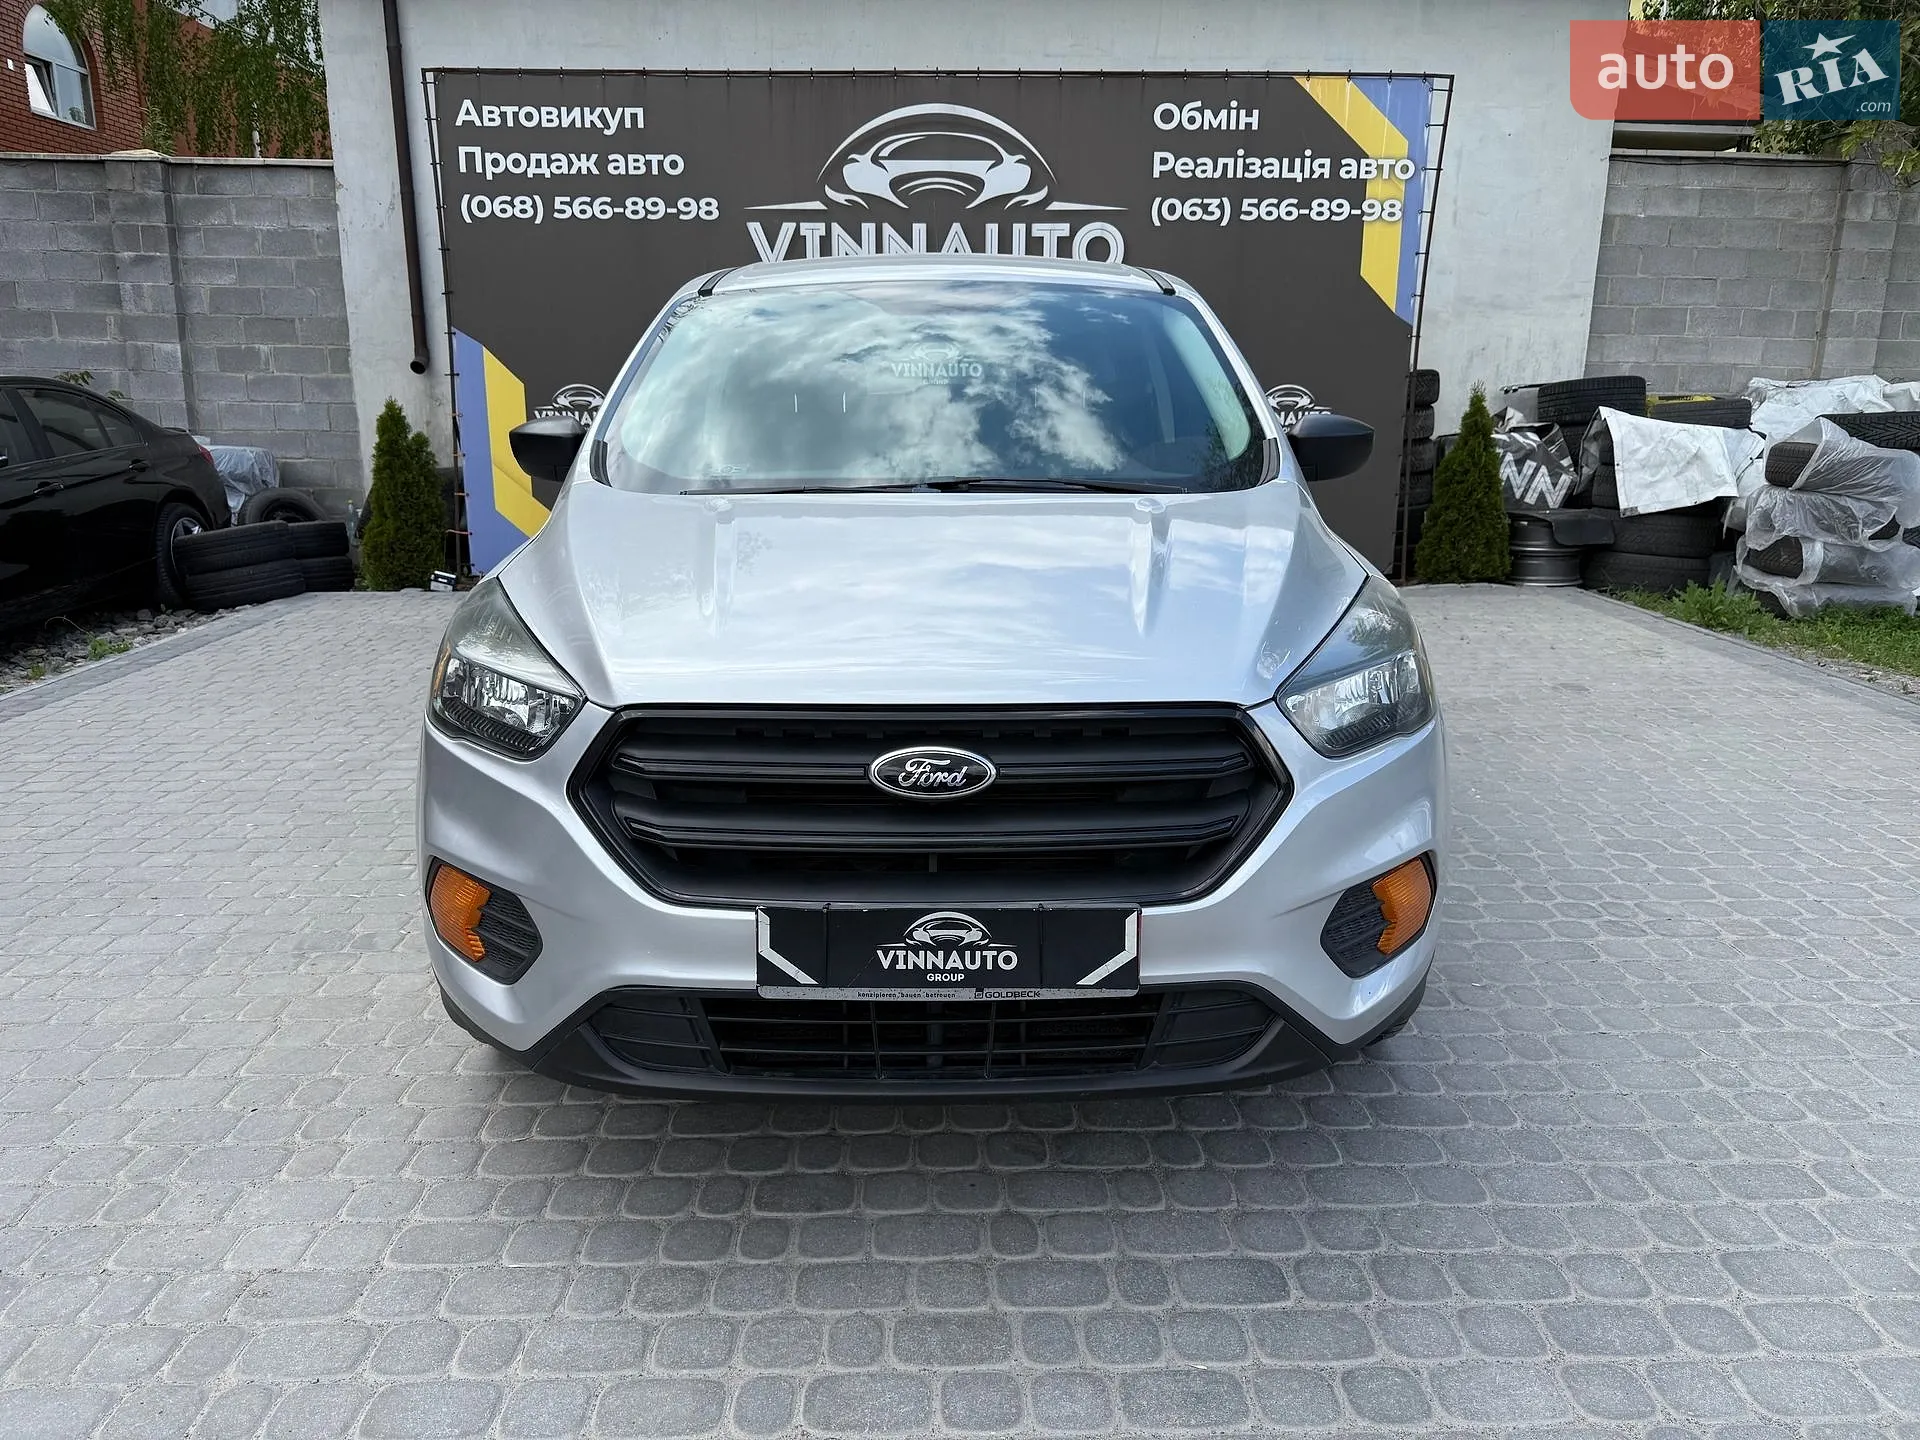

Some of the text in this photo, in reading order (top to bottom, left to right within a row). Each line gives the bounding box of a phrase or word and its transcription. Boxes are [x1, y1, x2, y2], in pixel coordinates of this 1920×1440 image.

[455, 99, 645, 135] Автовикуп
[1153, 100, 1260, 131] Обмін
[458, 146, 685, 180] Продаж авто
[1152, 148, 1416, 182] Реалізація авто
[460, 194, 720, 224] (068) 566-89-98
[1151, 197, 1402, 227] (063) 566-89-98
[899, 758, 968, 787] Ford
[876, 950, 1018, 970] VINNAUTO
[926, 972, 965, 982] GROUP
[985, 990, 1041, 998] GOLDBECK
